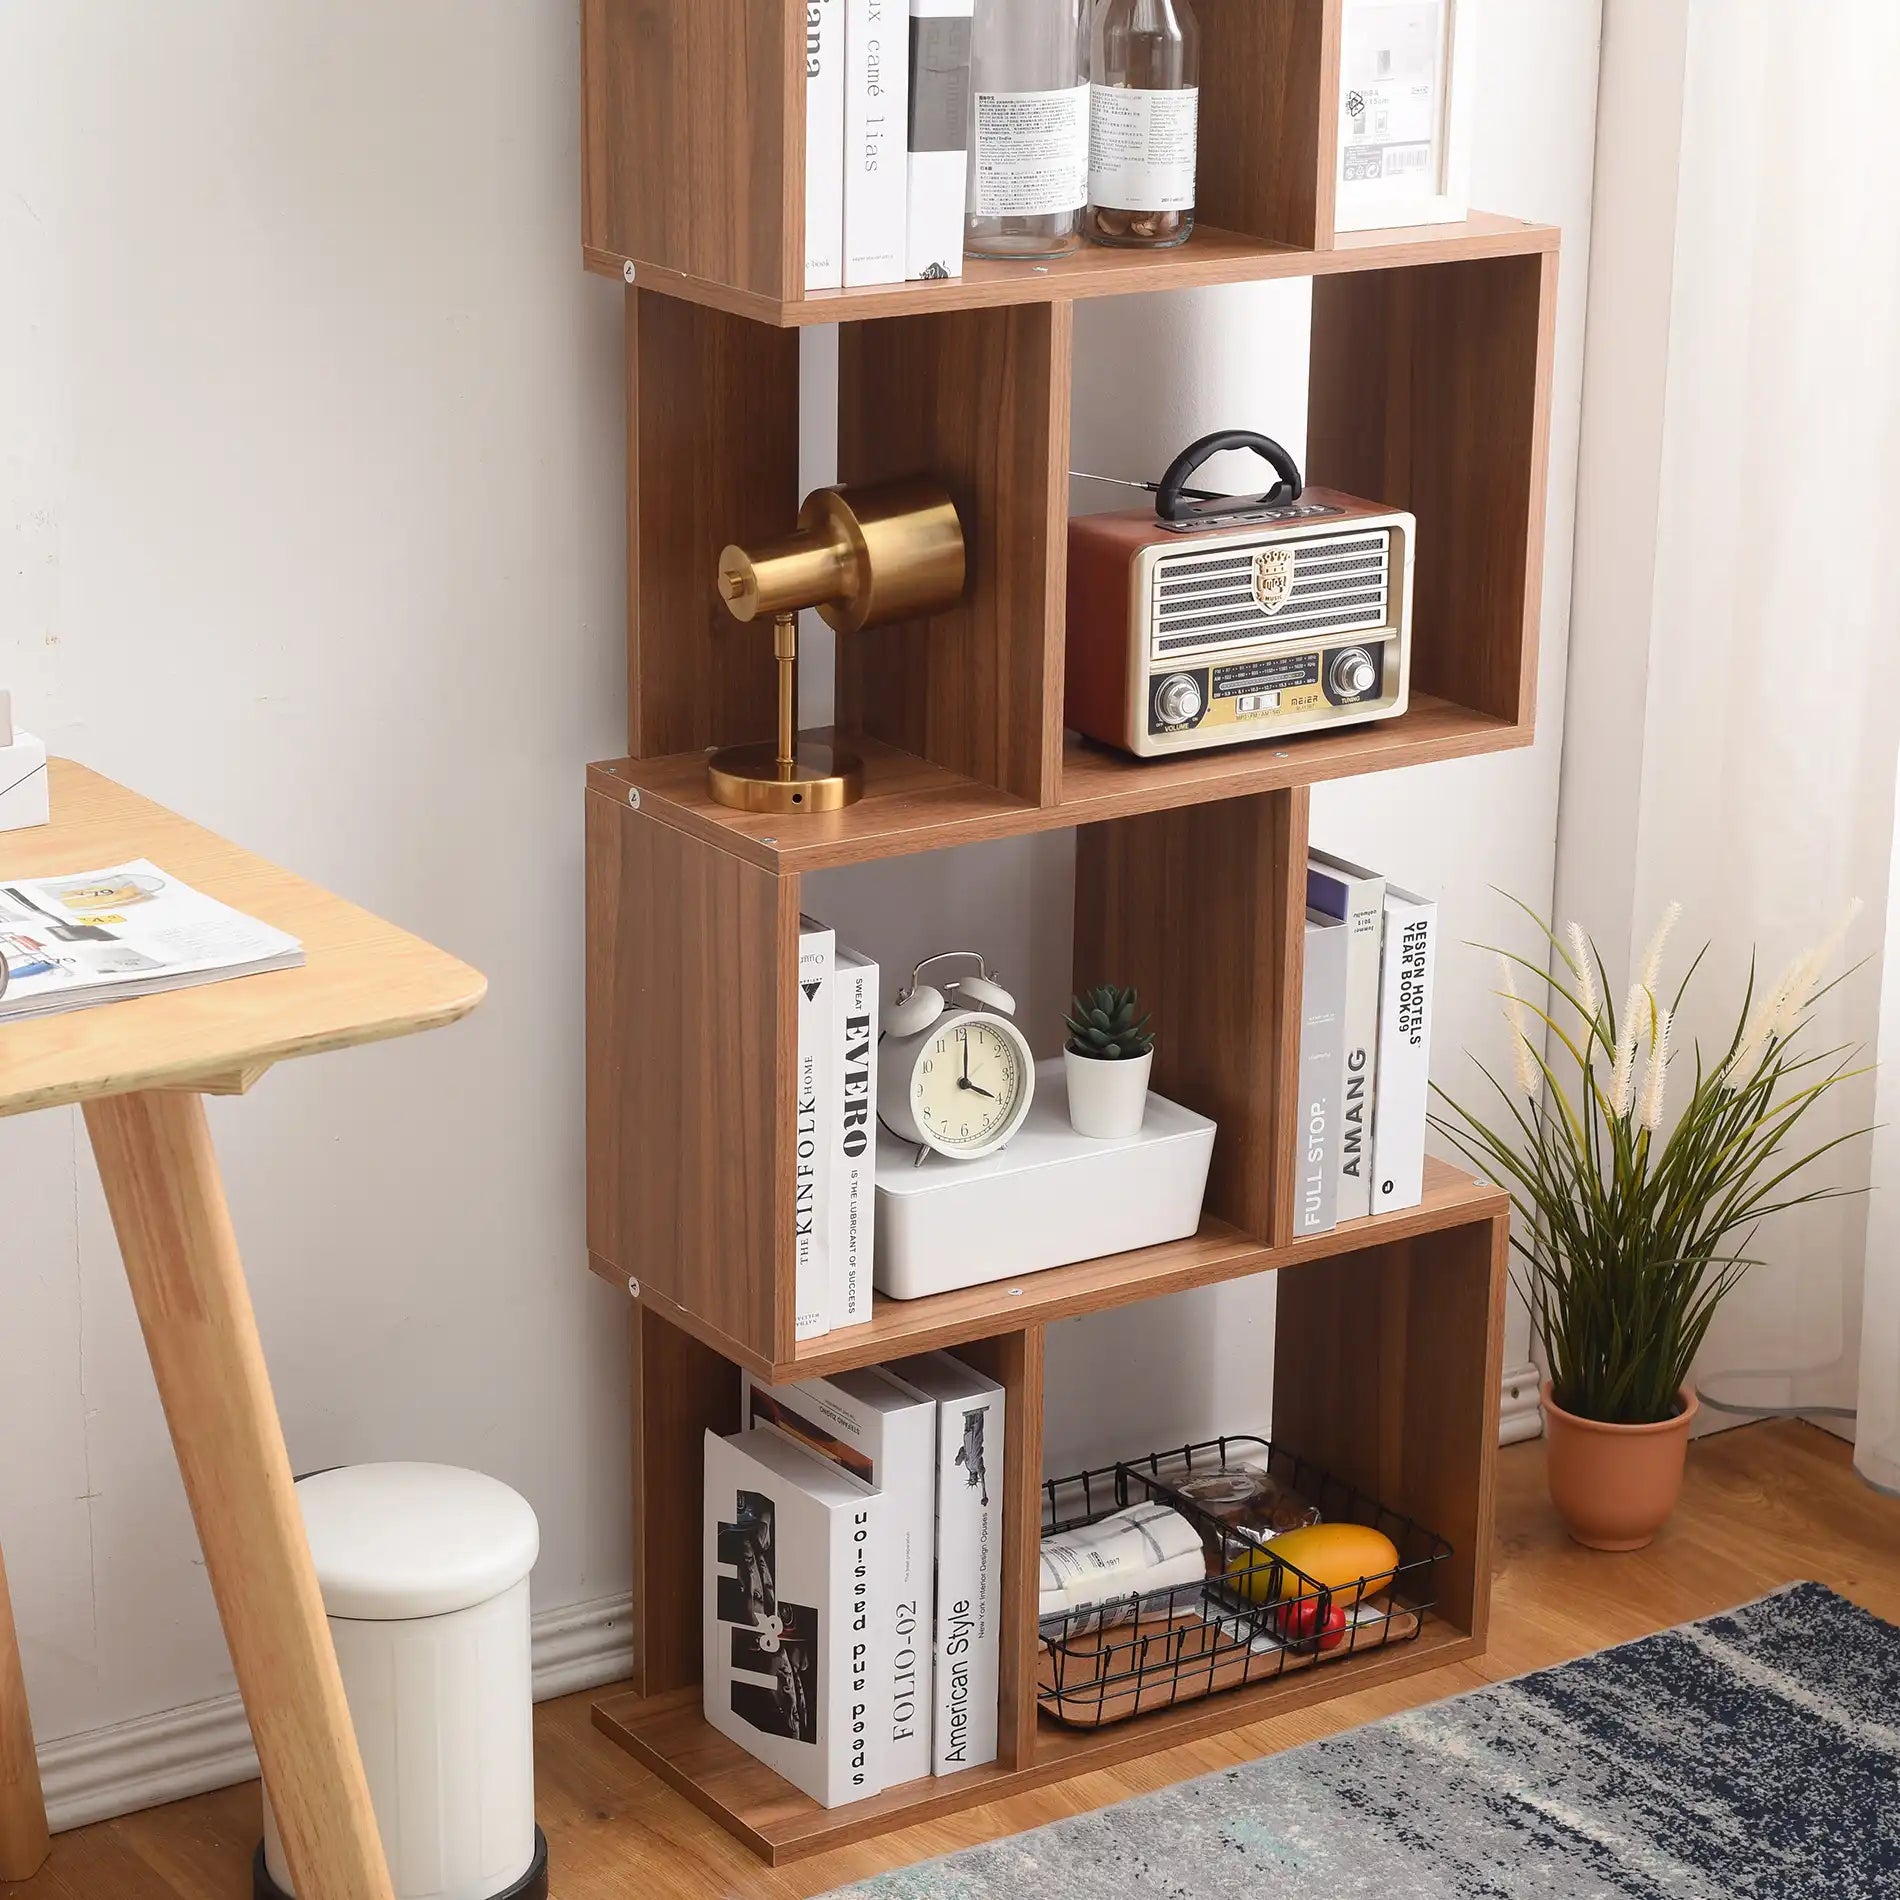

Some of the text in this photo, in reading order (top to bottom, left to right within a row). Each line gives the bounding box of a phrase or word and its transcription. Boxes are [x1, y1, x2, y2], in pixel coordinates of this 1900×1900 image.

[865, 114, 885, 172] lias
[1341, 696, 1361, 704] TUNING
[1164, 722, 1190, 732] VOLUME
[1402, 923, 1416, 964] YEAR
[1410, 921, 1428, 1045] DESIGN HOTELS
[954, 1028, 968, 1042] 12
[978, 1031, 984, 1044] 1
[936, 1040, 946, 1053] 11
[994, 1045, 1002, 1058] 2
[921, 1060, 933, 1074] 10
[1001, 1068, 1009, 1082] 3
[917, 1083, 924, 1098] 9
[994, 1092, 1003, 1106] 4
[923, 1106, 931, 1120] 8
[1342, 1047, 1367, 1178] AMANG
[940, 1120, 948, 1134] 7
[982, 1114, 990, 1127] 5
[960, 1123, 969, 1137] 6
[843, 978, 871, 1314] SWEAT EVERO IS THE LUBRICANT OF SUCCESS
[796, 1055, 816, 1266] THE KINFOLK HOME
[1305, 1167, 1323, 1227] FULL
[980, 1544, 988, 1571] Design
[1106, 1557, 1121, 1567] 1917
[851, 1511, 867, 1785] speed and passion
[893, 1600, 917, 1743] FOLIO-02
[945, 1599, 975, 1762] American Style
